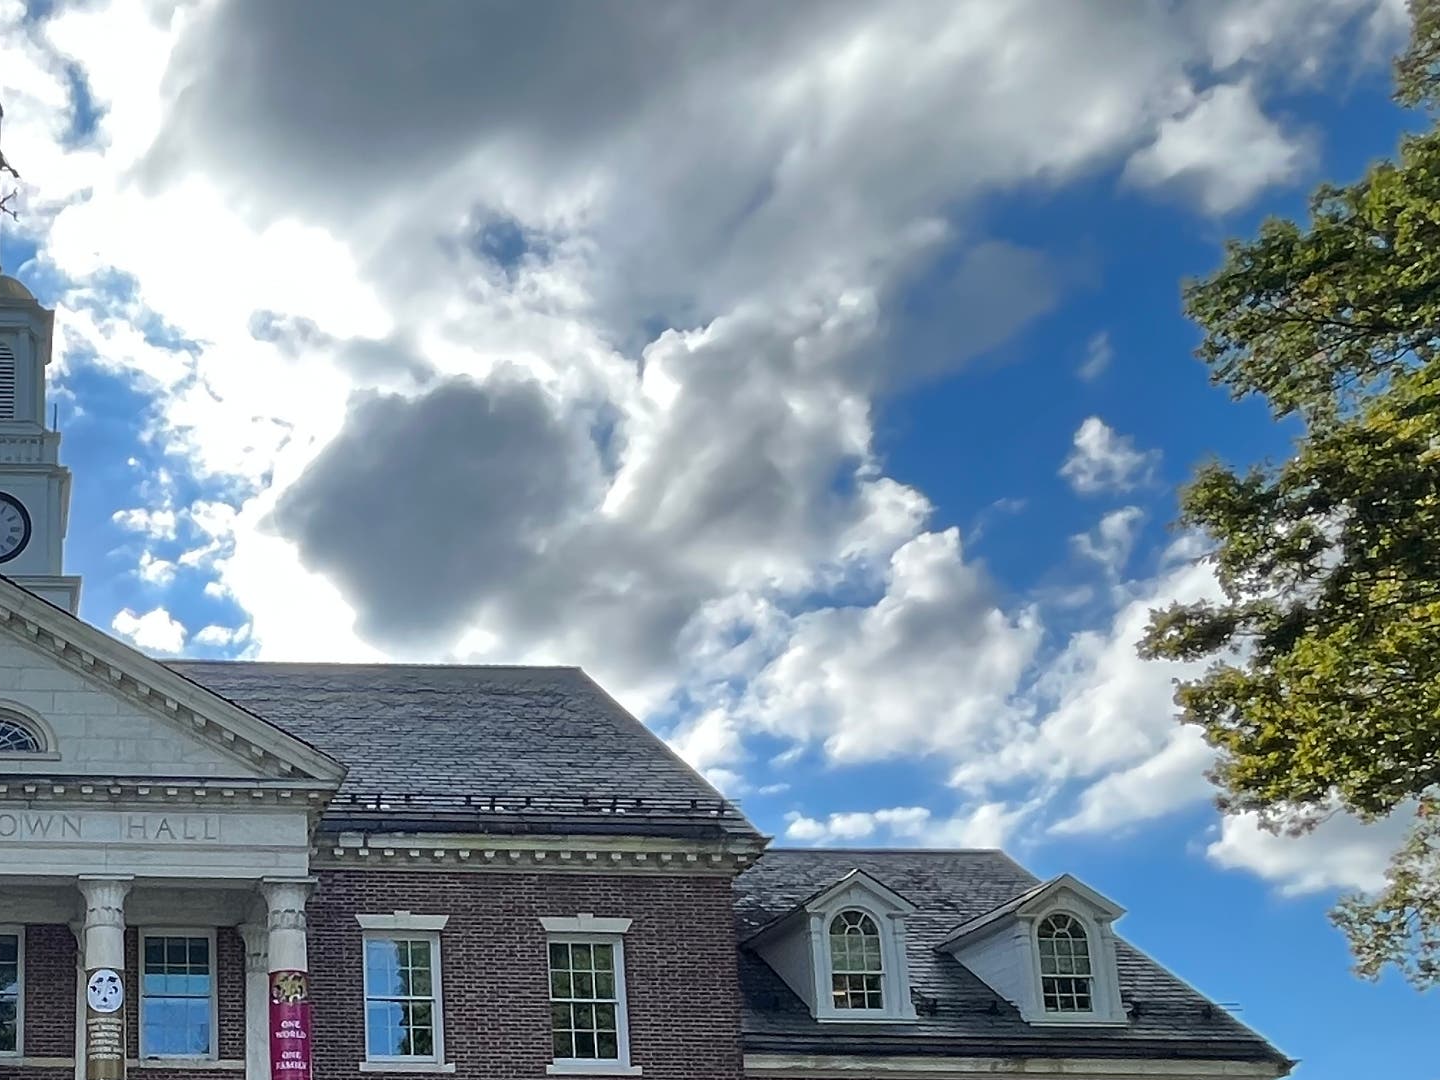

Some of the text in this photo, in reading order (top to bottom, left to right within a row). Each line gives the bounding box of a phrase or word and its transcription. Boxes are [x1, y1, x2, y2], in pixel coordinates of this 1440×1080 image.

[127, 815, 217, 840] HALL
[281, 1020, 302, 1029] ONE
[275, 1030, 307, 1039] WORLD
[281, 1051, 302, 1059] ONE
[276, 1061, 308, 1070] FAMILY
